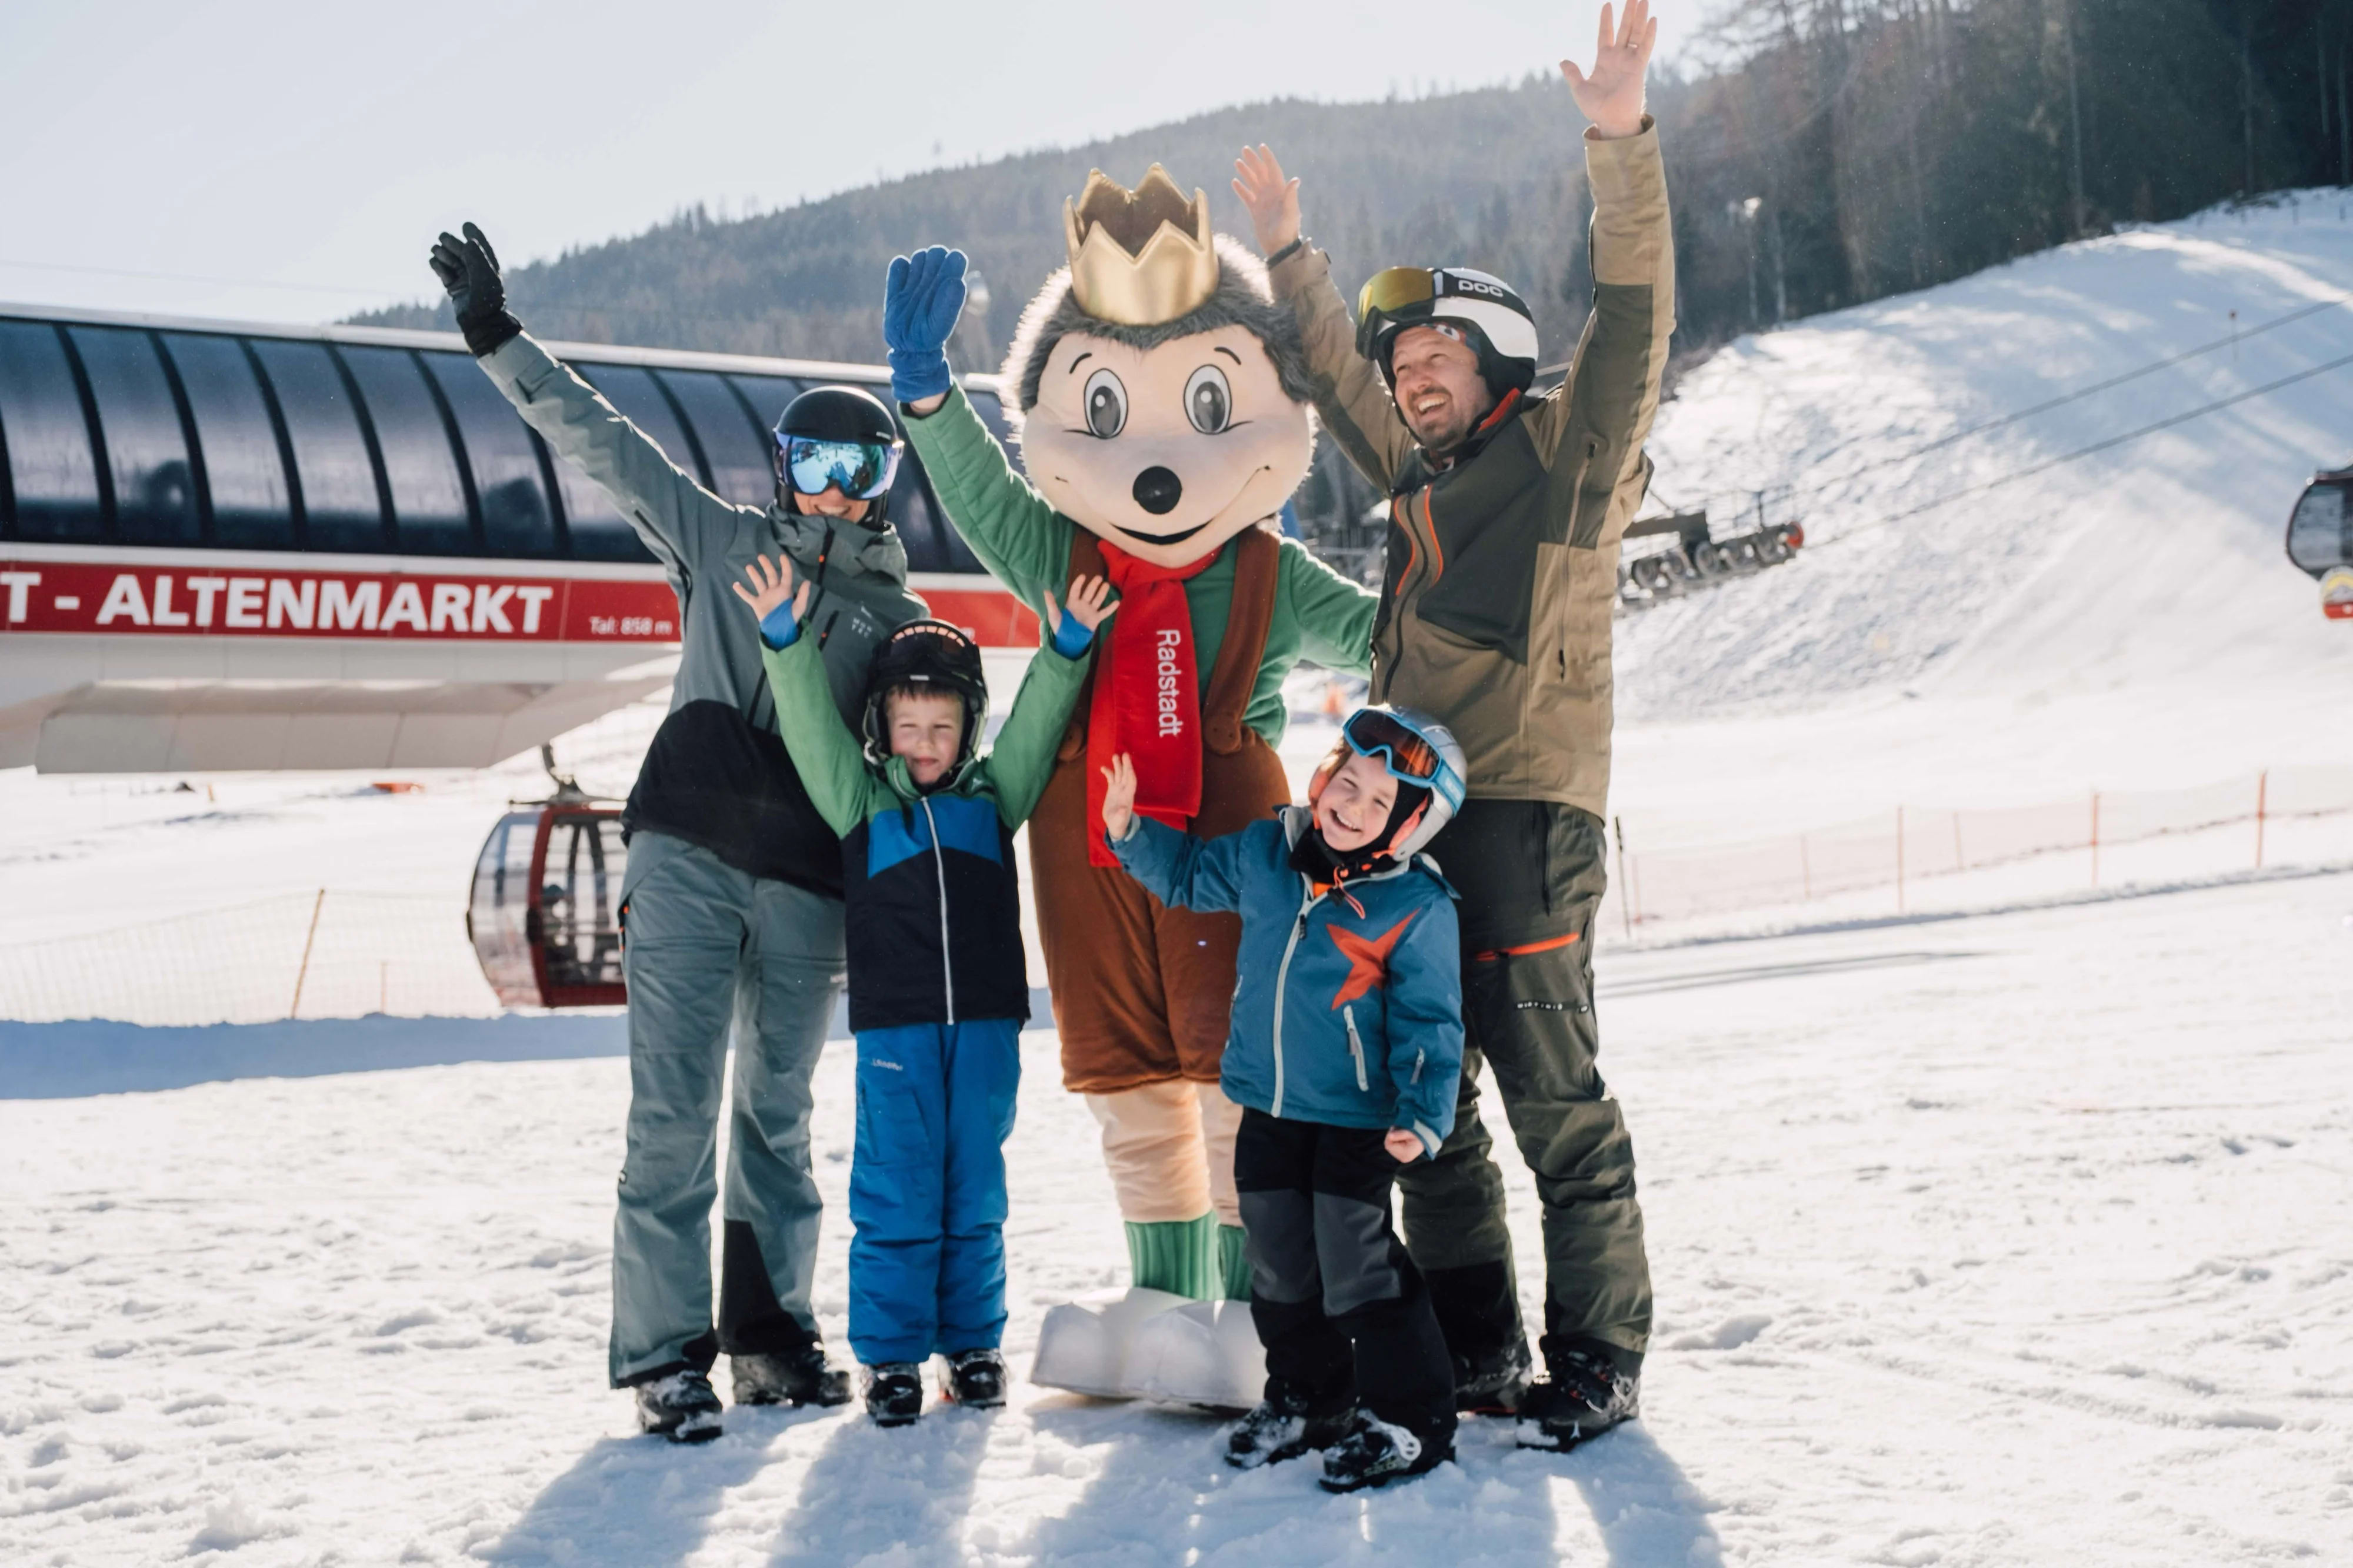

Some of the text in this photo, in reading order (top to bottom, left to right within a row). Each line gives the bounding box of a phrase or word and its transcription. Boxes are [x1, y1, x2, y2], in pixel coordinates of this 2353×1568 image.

[0, 571, 554, 633] T - ALTENMARKT
[621, 616, 653, 636] 858
[655, 620, 673, 636] m
[1156, 629, 1184, 738] Radstadt
